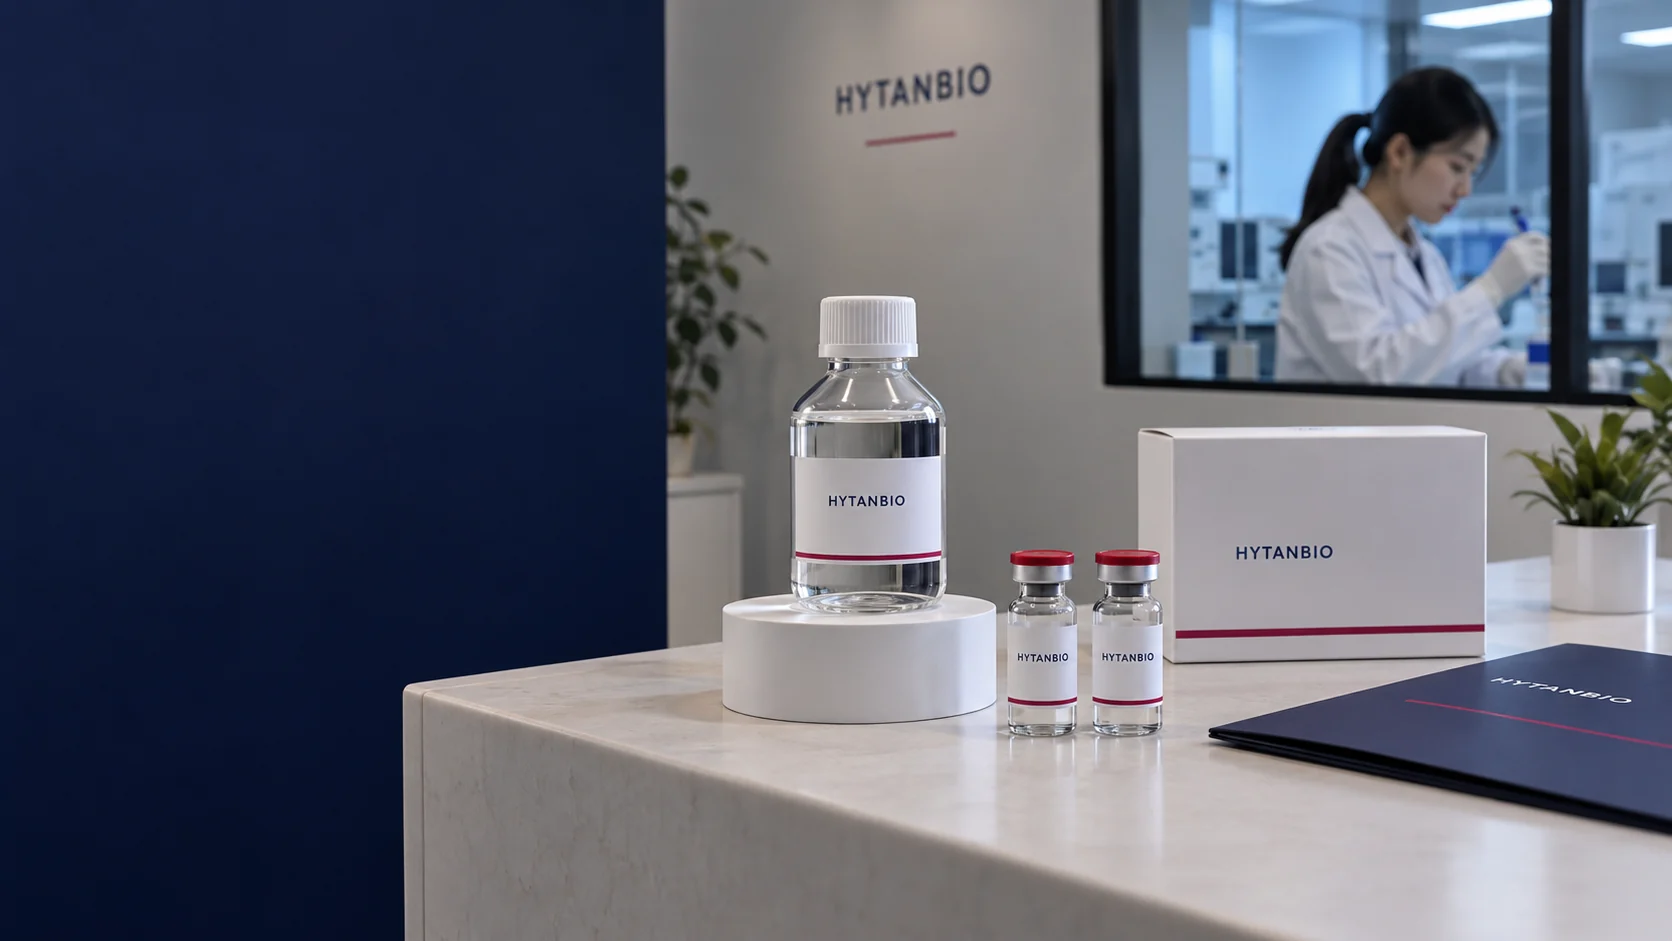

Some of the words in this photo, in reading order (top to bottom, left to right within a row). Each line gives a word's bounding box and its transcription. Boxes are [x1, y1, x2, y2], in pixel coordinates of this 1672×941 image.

[836, 63, 991, 115] HYTANBIO
[828, 494, 906, 507] HYTANBIO
[1236, 545, 1334, 560] HYTANBIO
[1017, 652, 1069, 663] HYTANBIO
[1102, 652, 1155, 663] HYTANBIO
[1490, 676, 1632, 704] HYTANBIO
